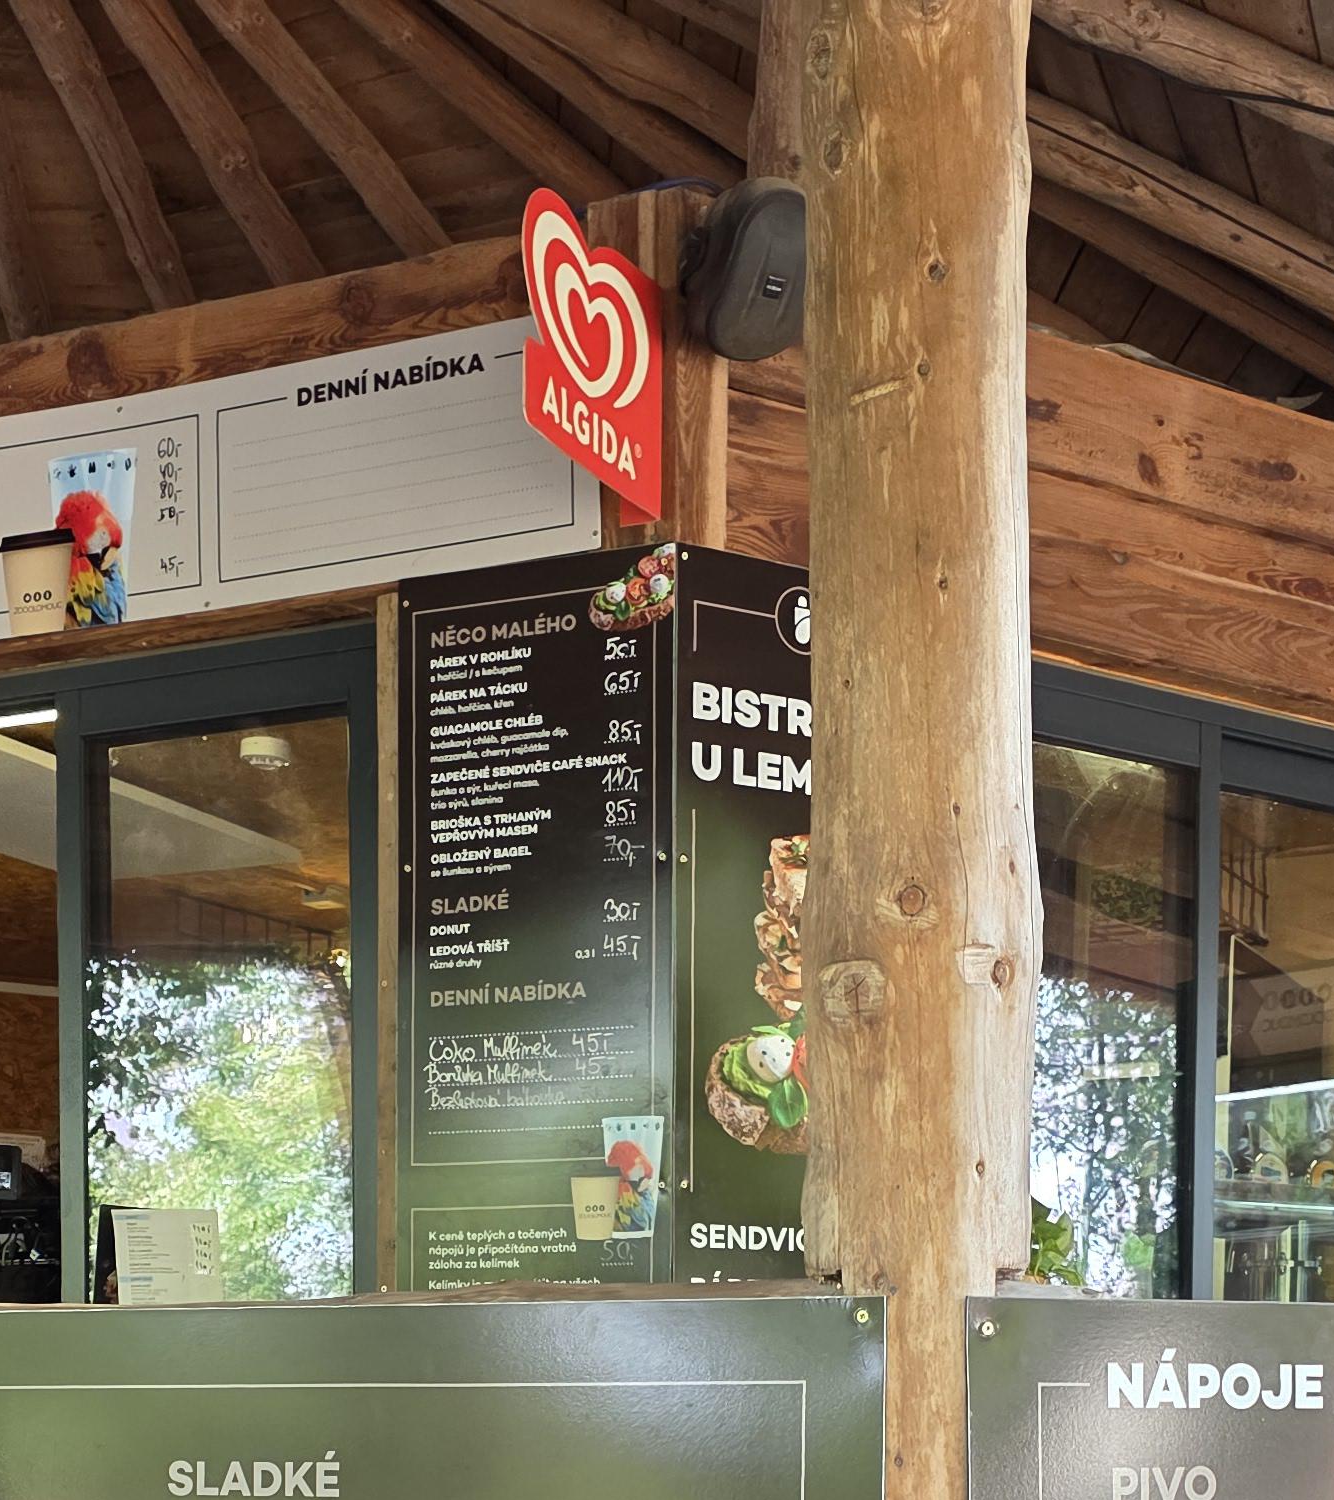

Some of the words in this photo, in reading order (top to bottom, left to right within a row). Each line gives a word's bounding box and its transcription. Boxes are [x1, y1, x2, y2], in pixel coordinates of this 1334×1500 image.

[297, 368, 368, 406] DENNÍ
[375, 354, 485, 392] NABÍDKA
[542, 375, 636, 482] ALGIDA
[431, 625, 486, 648] NĚCO
[492, 613, 576, 640] MALÉHO
[431, 656, 467, 669] PÁREK
[469, 654, 478, 664] V
[481, 646, 531, 662] ROHLÍKU
[431, 766, 489, 784] ZAPEČENÉ
[493, 760, 550, 777] SENDVIČE
[552, 756, 583, 770] CAFÉ
[585, 753, 627, 767] SNACK
[692, 742, 721, 781] U
[431, 847, 492, 865] OBLOŽENÝ
[494, 846, 531, 858] BAGEL
[431, 888, 509, 914] SLADKÉ
[430, 924, 471, 936] DONUT
[456, 958, 481, 968] druhy
[431, 983, 489, 1007] DENNÍ
[495, 980, 586, 1003] NABÍDKA
[429, 1244, 463, 1258] nápojů
[478, 1244, 538, 1256] připočítána
[541, 1242, 576, 1252] vratná
[467, 1230, 505, 1246] teplých
[518, 1228, 567, 1241] točených
[480, 1258, 519, 1268] kelímek
[1108, 1348, 1323, 1409] NÁPOJE
[168, 1451, 339, 1497] SLADKÉ
